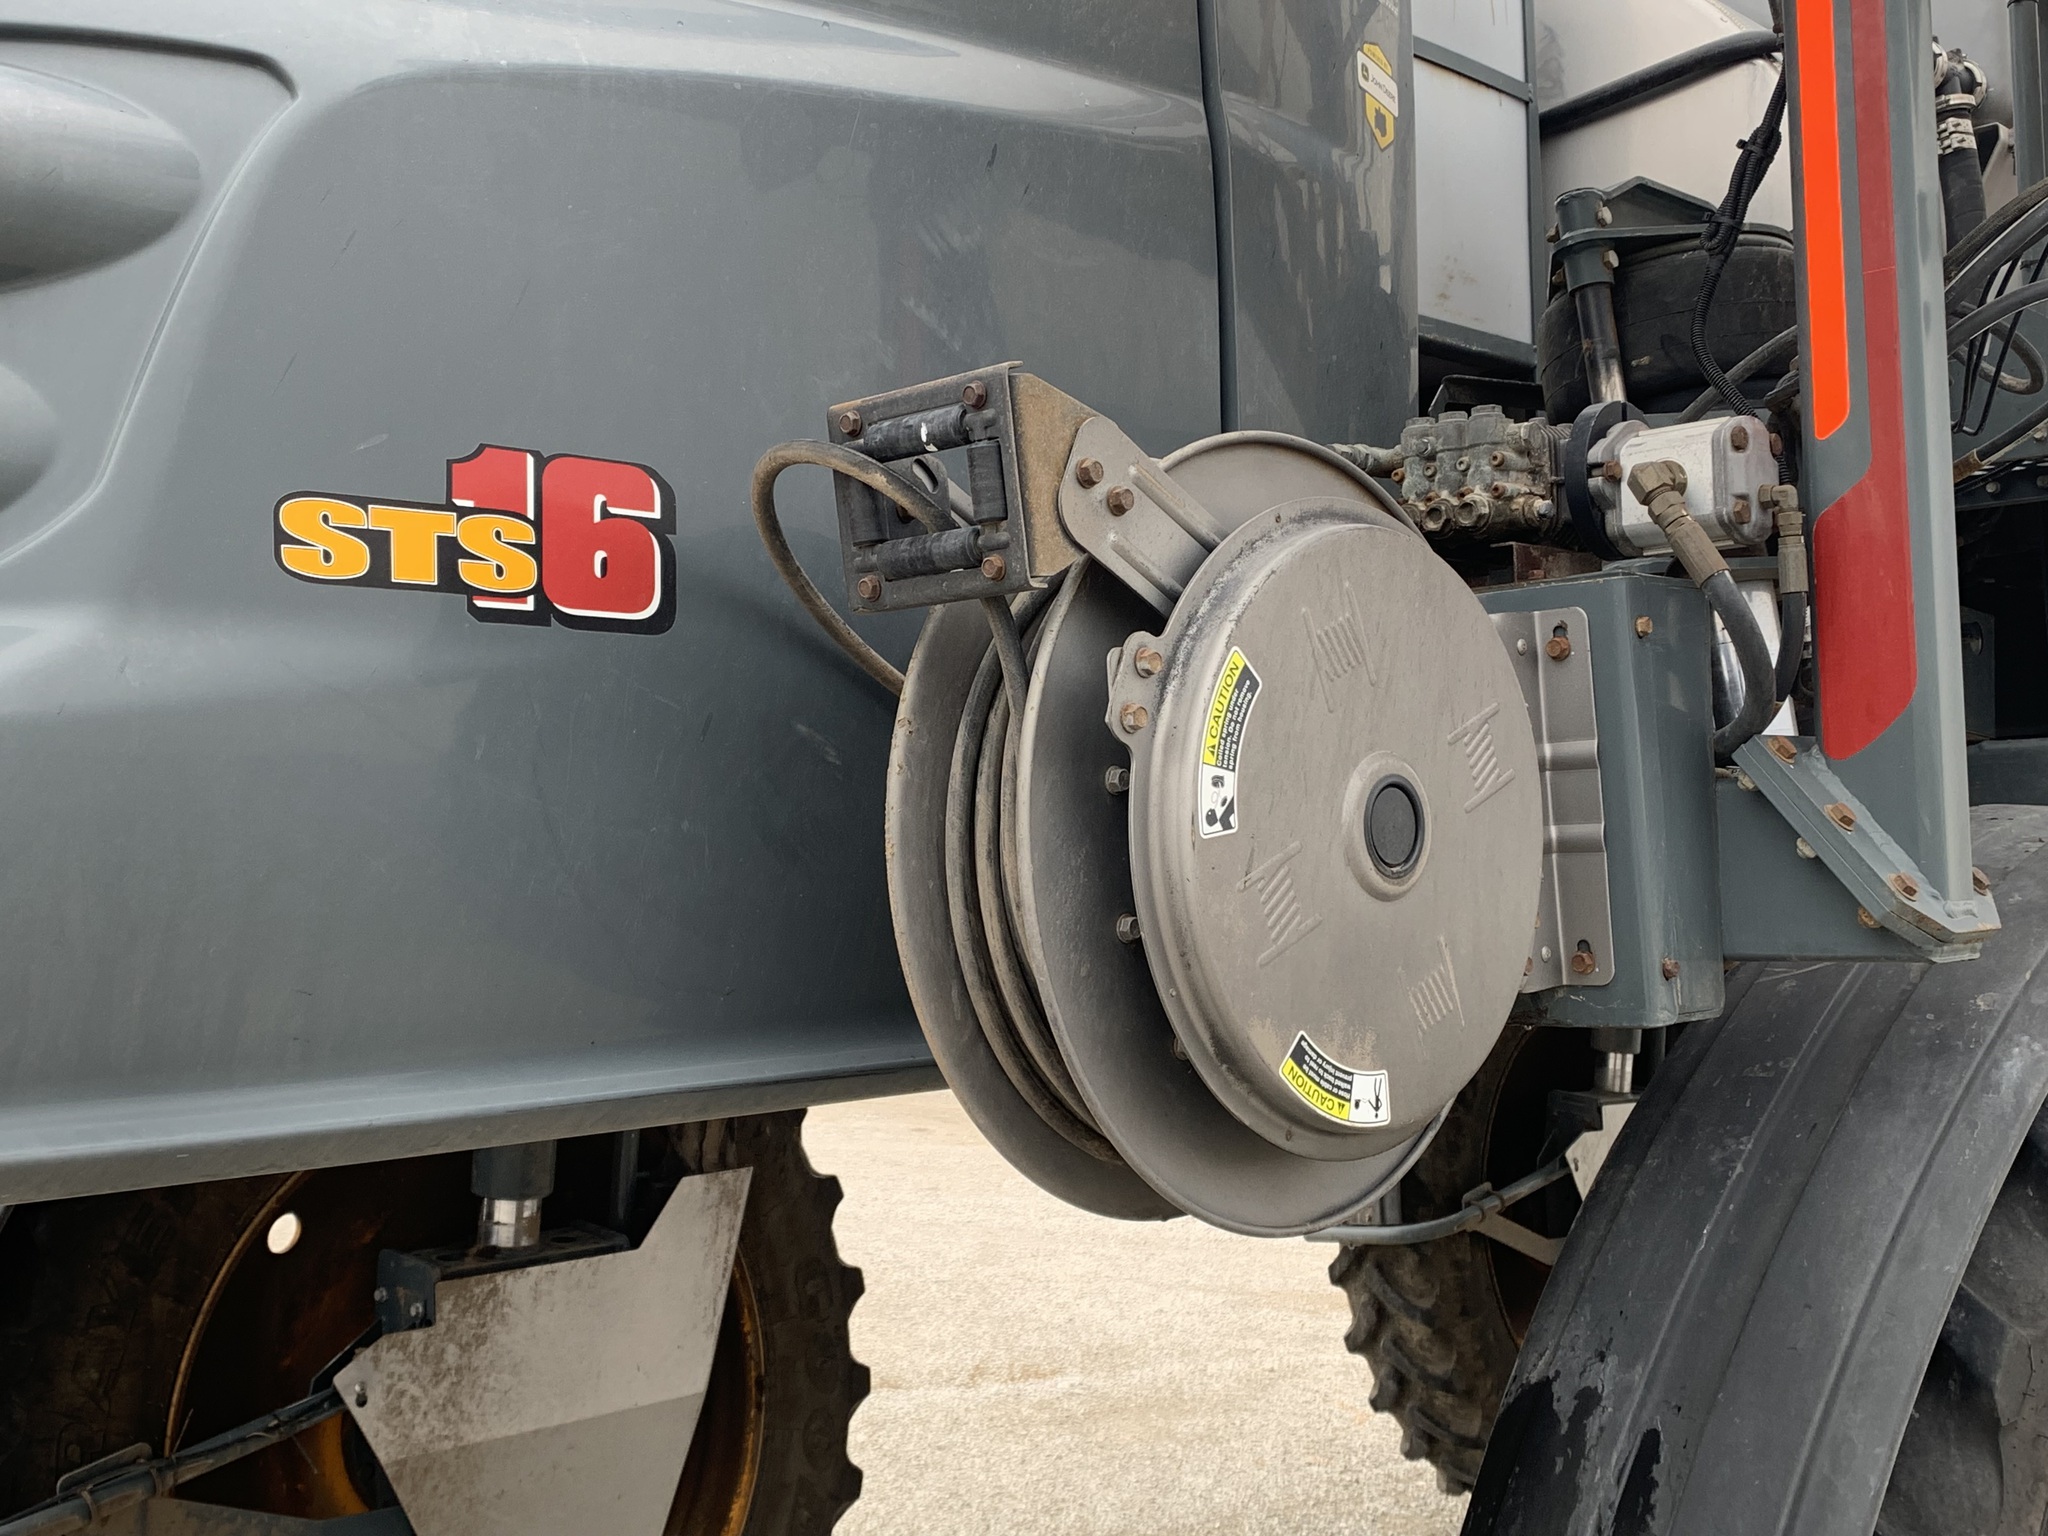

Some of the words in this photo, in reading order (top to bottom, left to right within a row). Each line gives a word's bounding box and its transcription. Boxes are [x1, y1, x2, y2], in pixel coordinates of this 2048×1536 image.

[279, 496, 538, 593] STS
[451, 445, 661, 621] 16
[1209, 661, 1239, 739] CAUTION
[1217, 739, 1225, 767] Coiled
[1222, 713, 1232, 738] spring
[1229, 688, 1239, 711] under
[1223, 735, 1232, 768] tension.
[1228, 721, 1235, 733] Do
[1237, 679, 1250, 705] remove
[1237, 692, 1253, 723] housing.
[1228, 742, 1238, 770] spring
[1232, 723, 1241, 742] from
[1288, 1066, 1334, 1111] CAUTION
